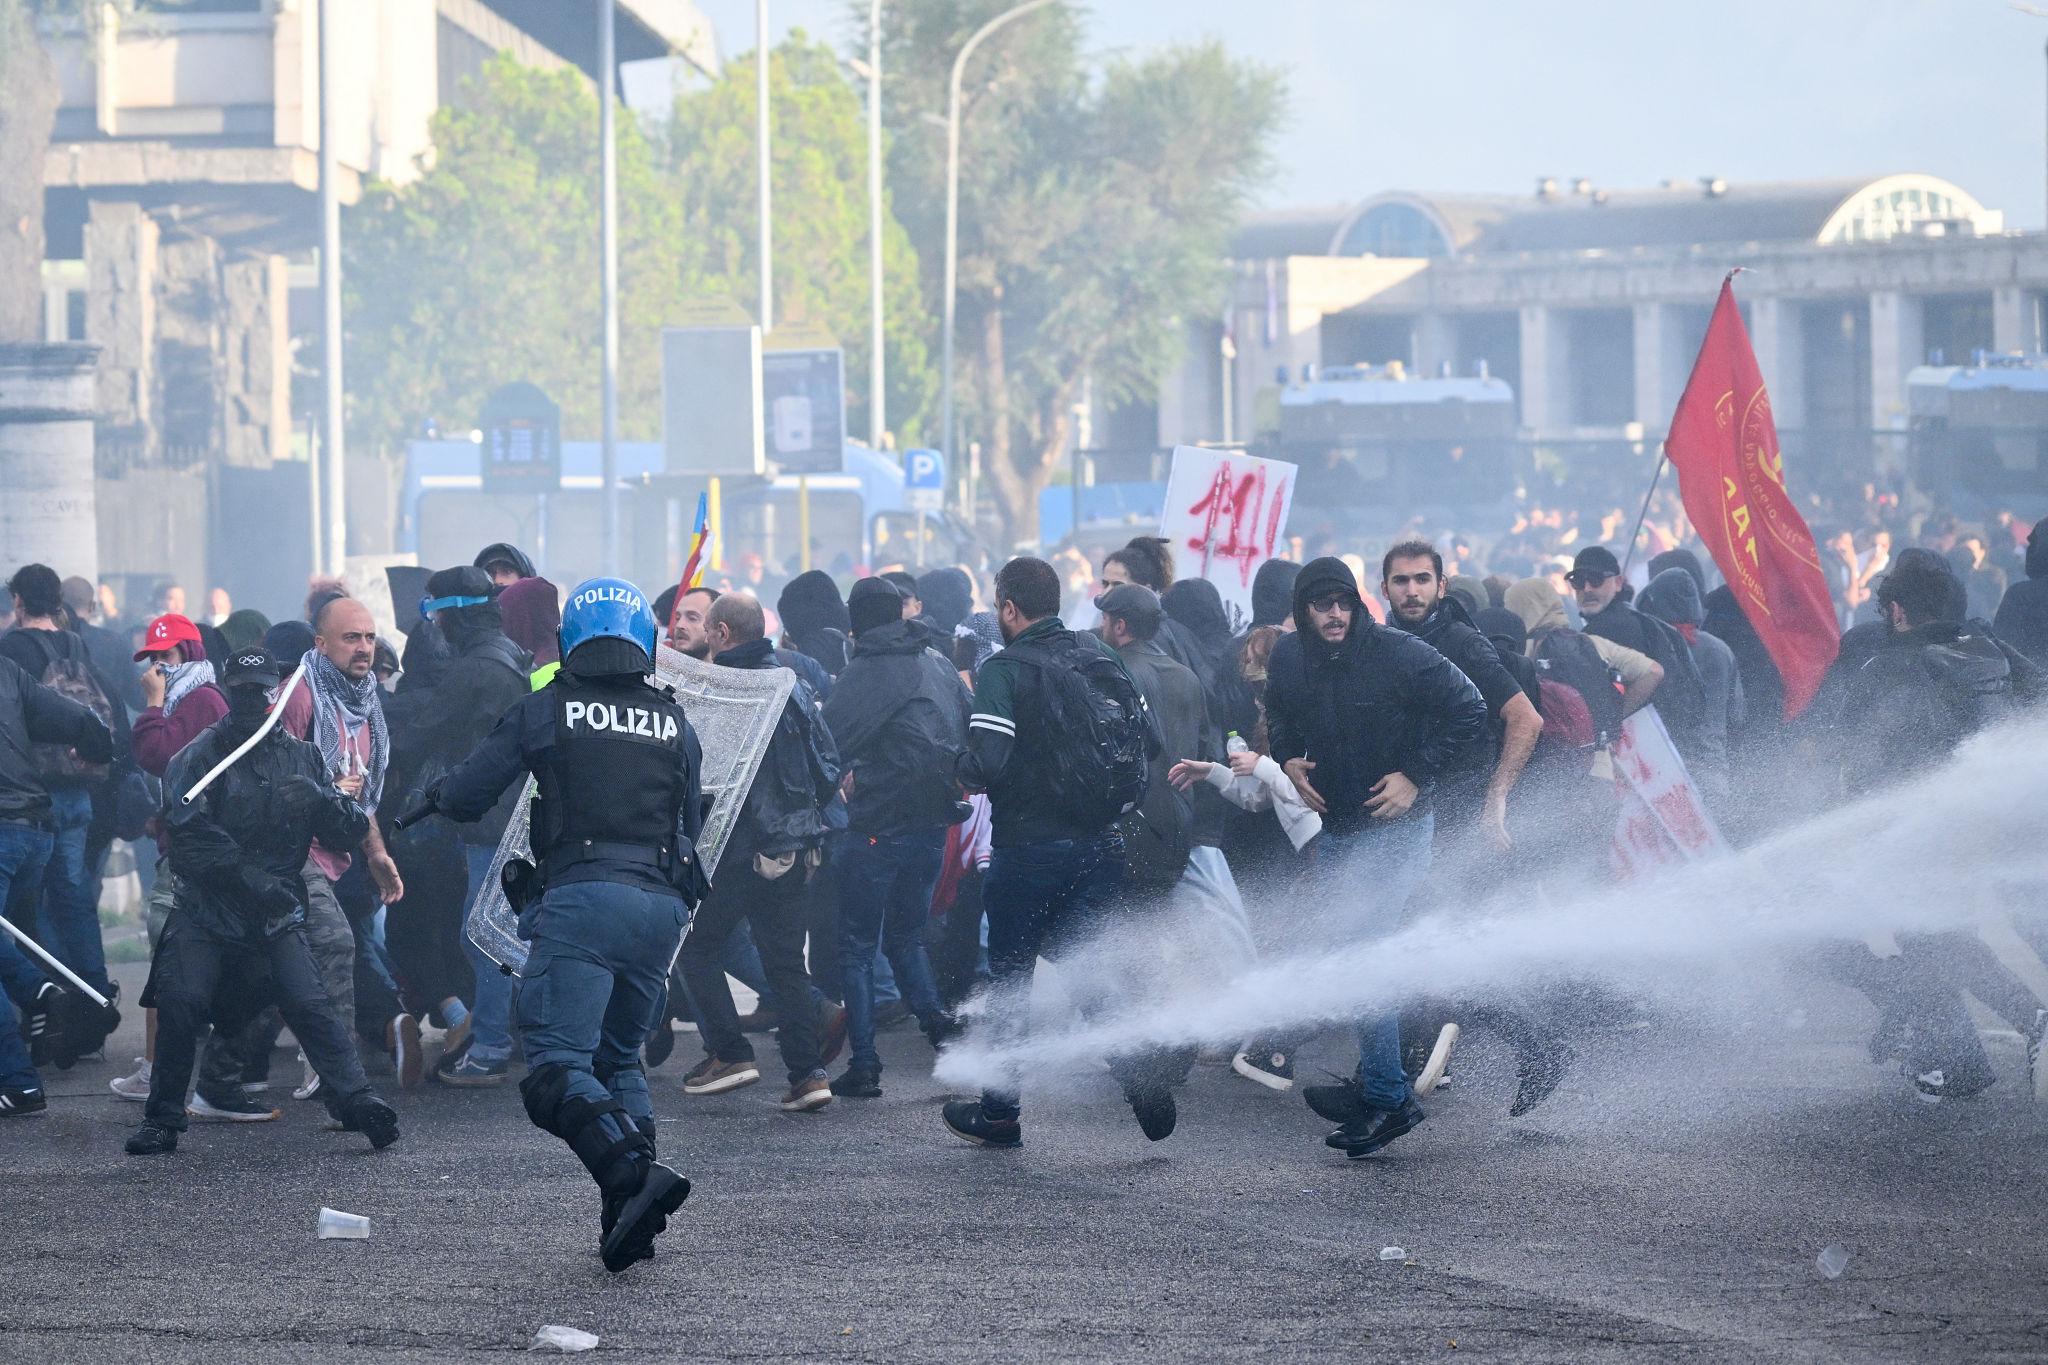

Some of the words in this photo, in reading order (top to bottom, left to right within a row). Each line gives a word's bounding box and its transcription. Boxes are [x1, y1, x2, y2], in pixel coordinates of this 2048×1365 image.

[912, 455, 934, 482] P
[573, 587, 641, 612] POLIZIA
[565, 701, 678, 741] POLIZIA
